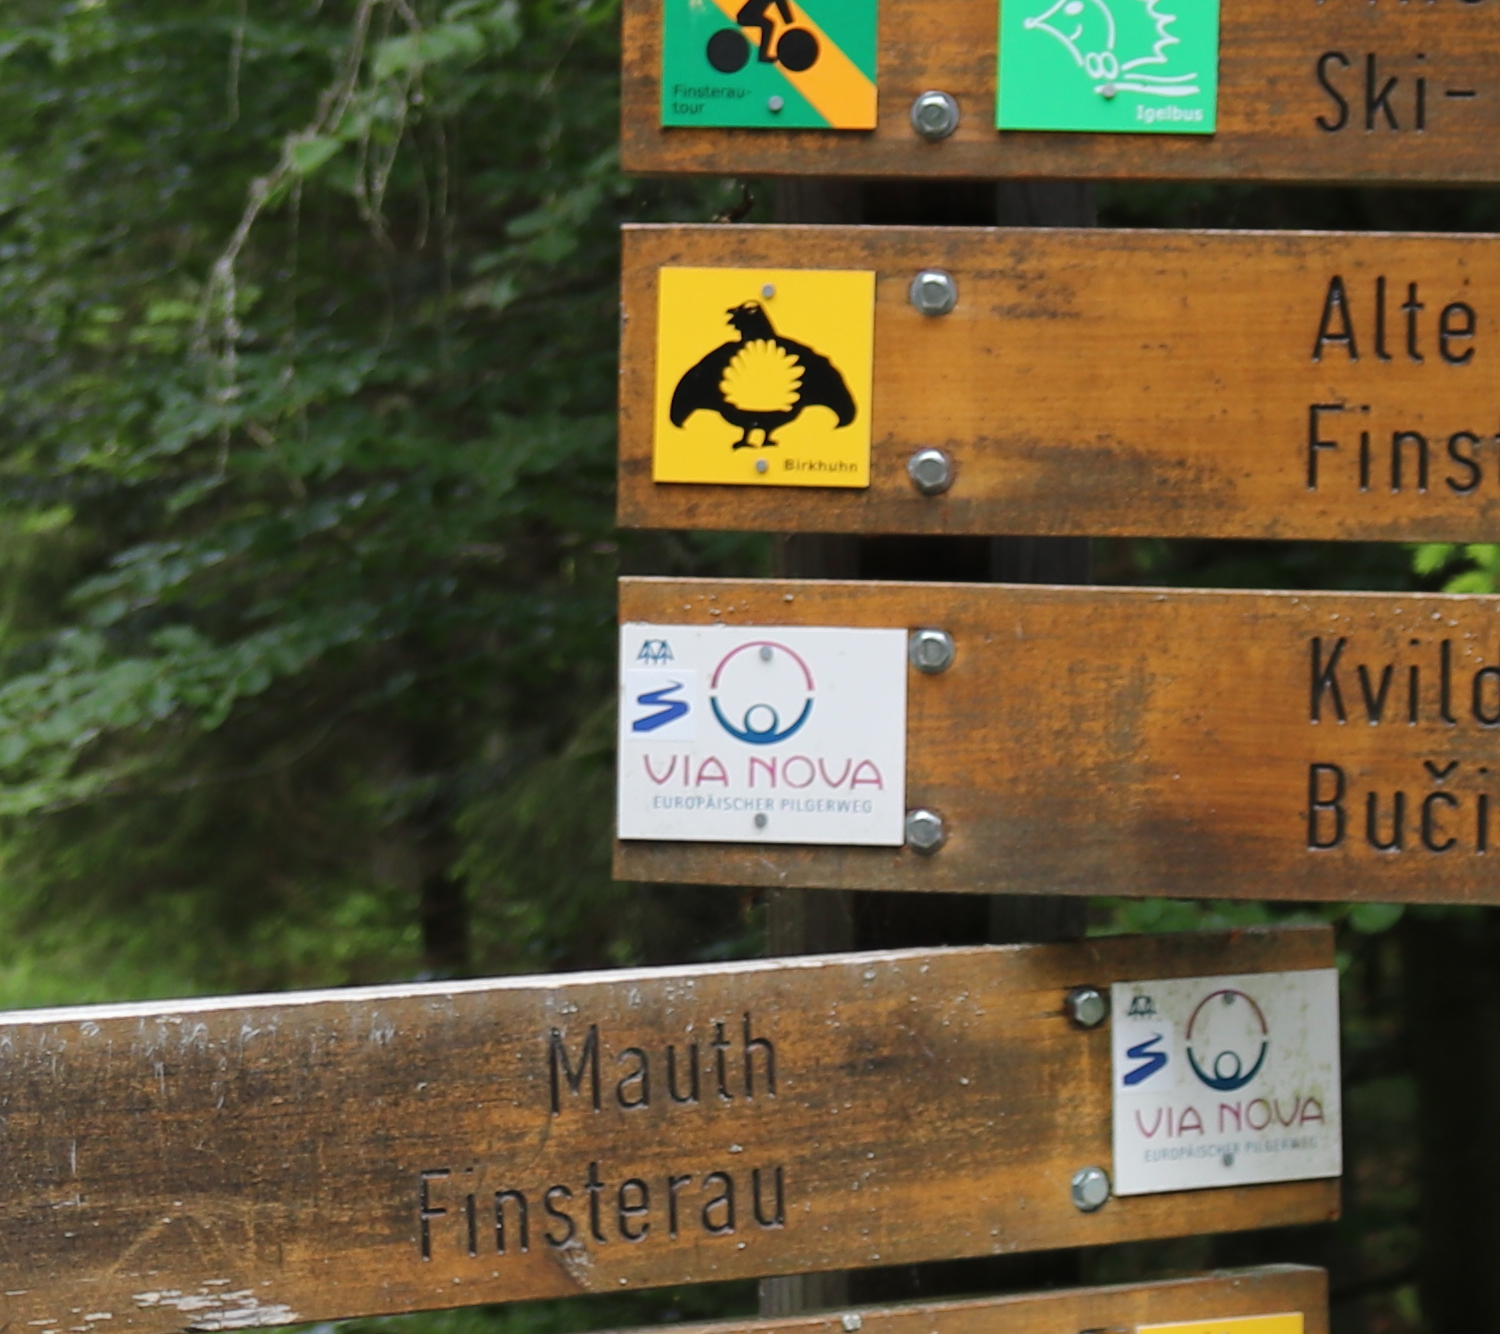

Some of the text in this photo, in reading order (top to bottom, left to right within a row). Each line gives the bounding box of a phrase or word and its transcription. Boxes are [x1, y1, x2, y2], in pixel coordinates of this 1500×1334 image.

[672, 83, 753, 99] Finsterau-
[672, 102, 705, 115] tour
[1315, 51, 1478, 134] Ski-
[1136, 104, 1204, 124] Igelbus
[1311, 274, 1477, 365] Alte
[784, 458, 858, 473] Birkhuhn
[643, 754, 884, 790] VIA NOVA
[653, 794, 873, 813] EUROPÄISCHER PILGERWEG
[548, 1011, 778, 1118] Mauth
[1135, 1097, 1325, 1138] VIA NOVA
[420, 1161, 787, 1262] Finsterau
